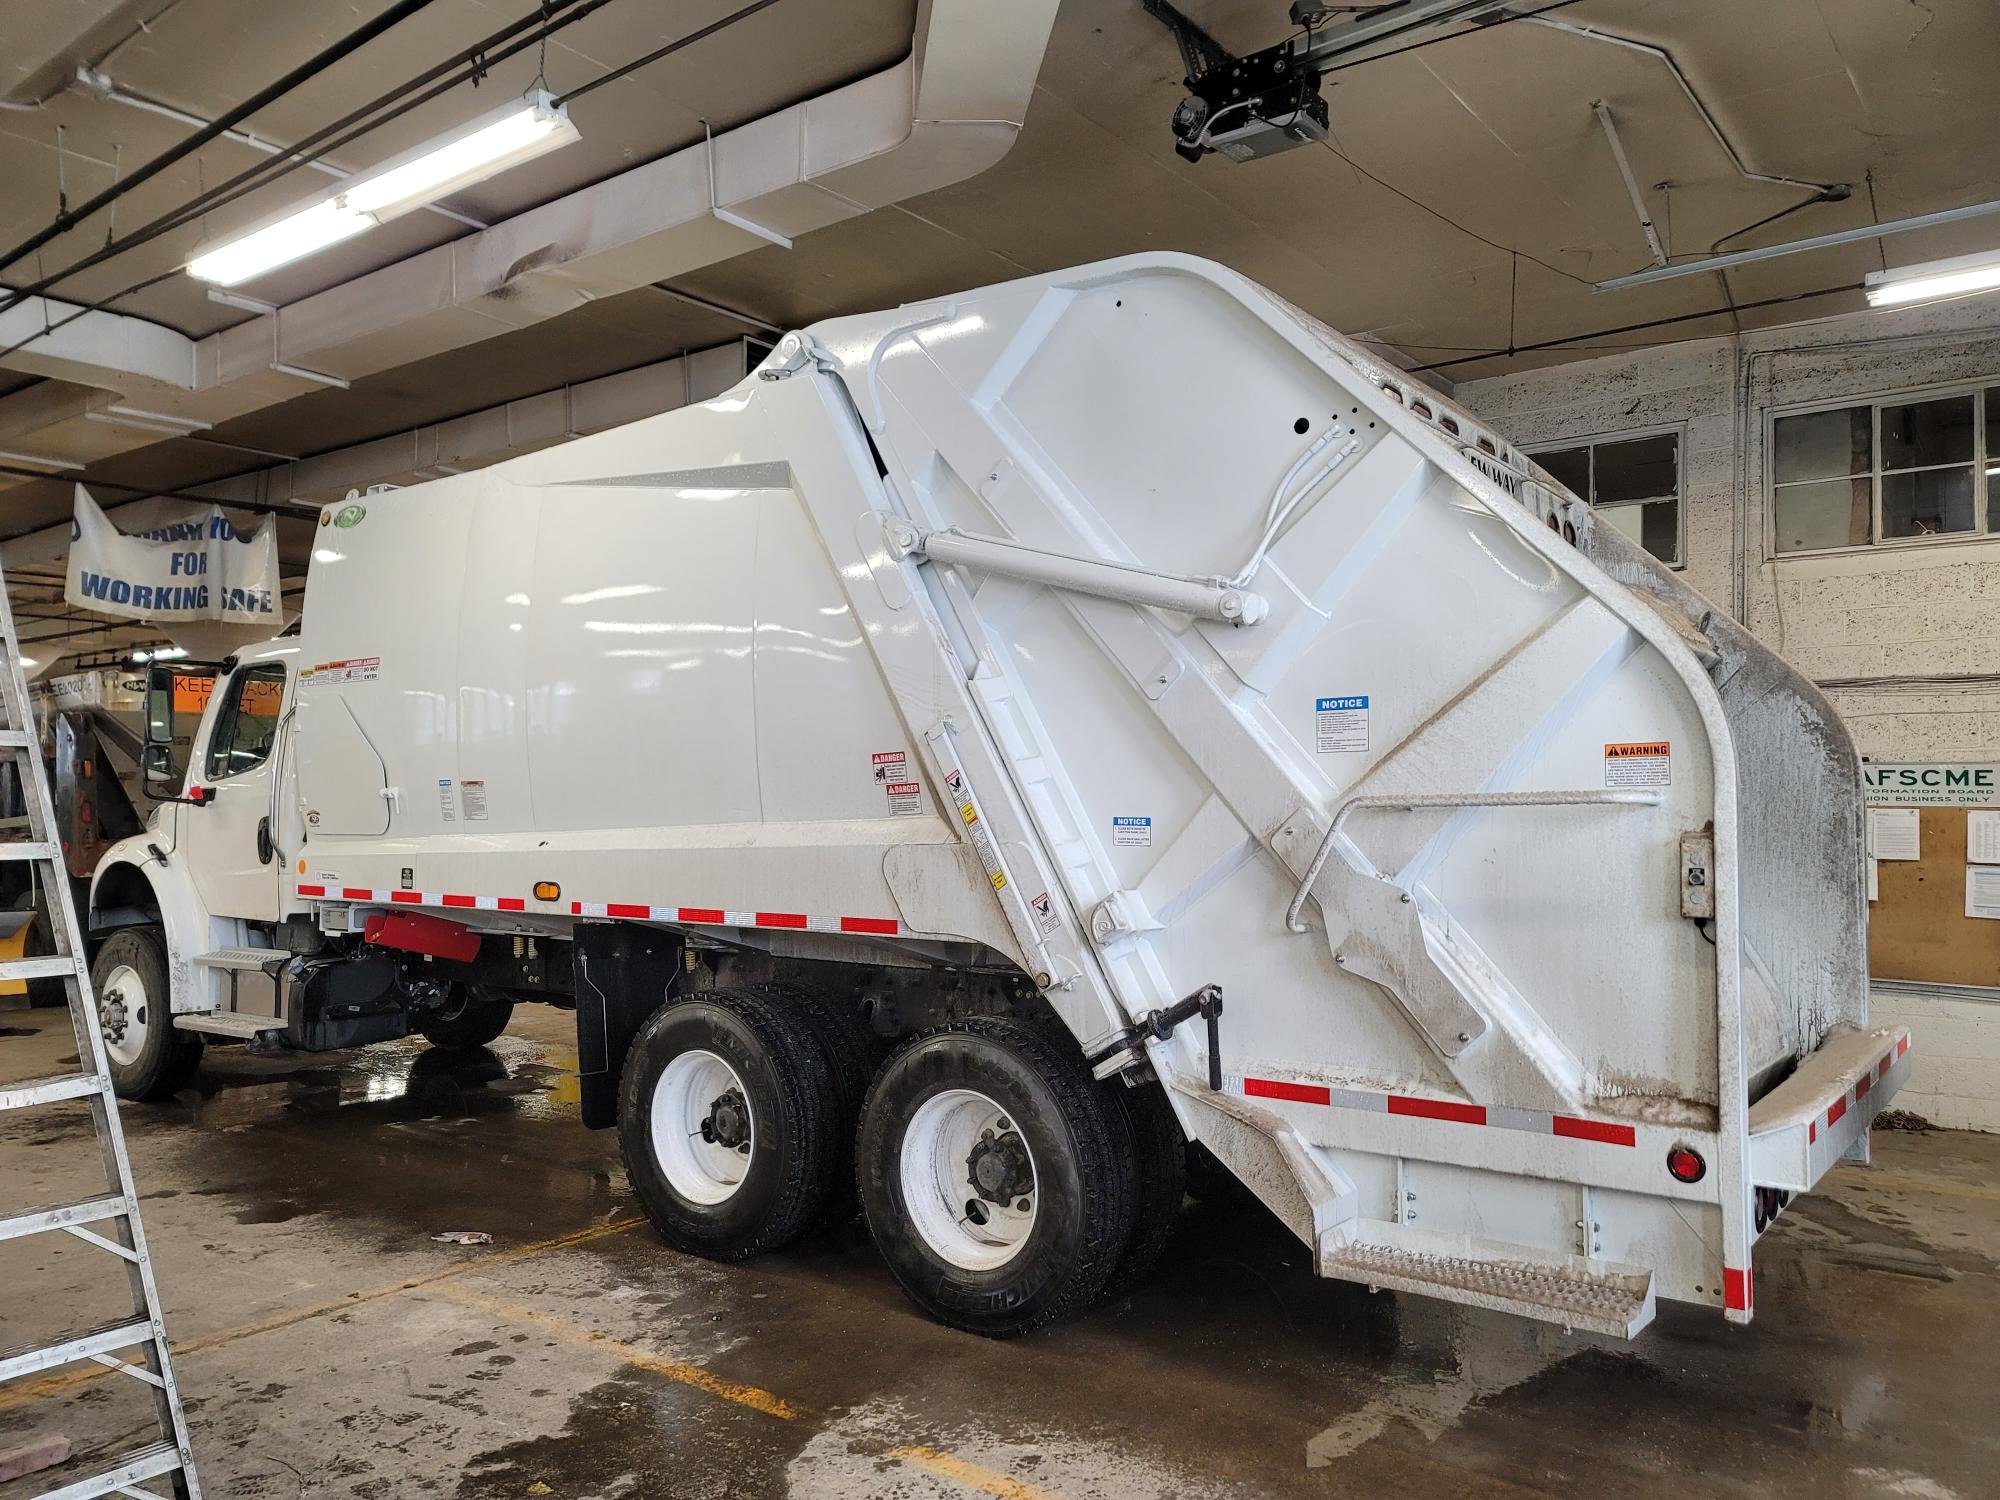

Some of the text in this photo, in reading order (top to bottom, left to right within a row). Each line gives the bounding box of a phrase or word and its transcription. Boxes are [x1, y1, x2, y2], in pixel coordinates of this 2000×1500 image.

[170, 552, 208, 576] FOR
[81, 571, 273, 614] WORKING SAFE
[175, 677, 280, 697] KEE ACK
[1322, 699, 1363, 709] NOTICE
[1620, 745, 1667, 756] WARNING
[880, 753, 905, 763] DANGER
[894, 784, 919, 794] DANGER
